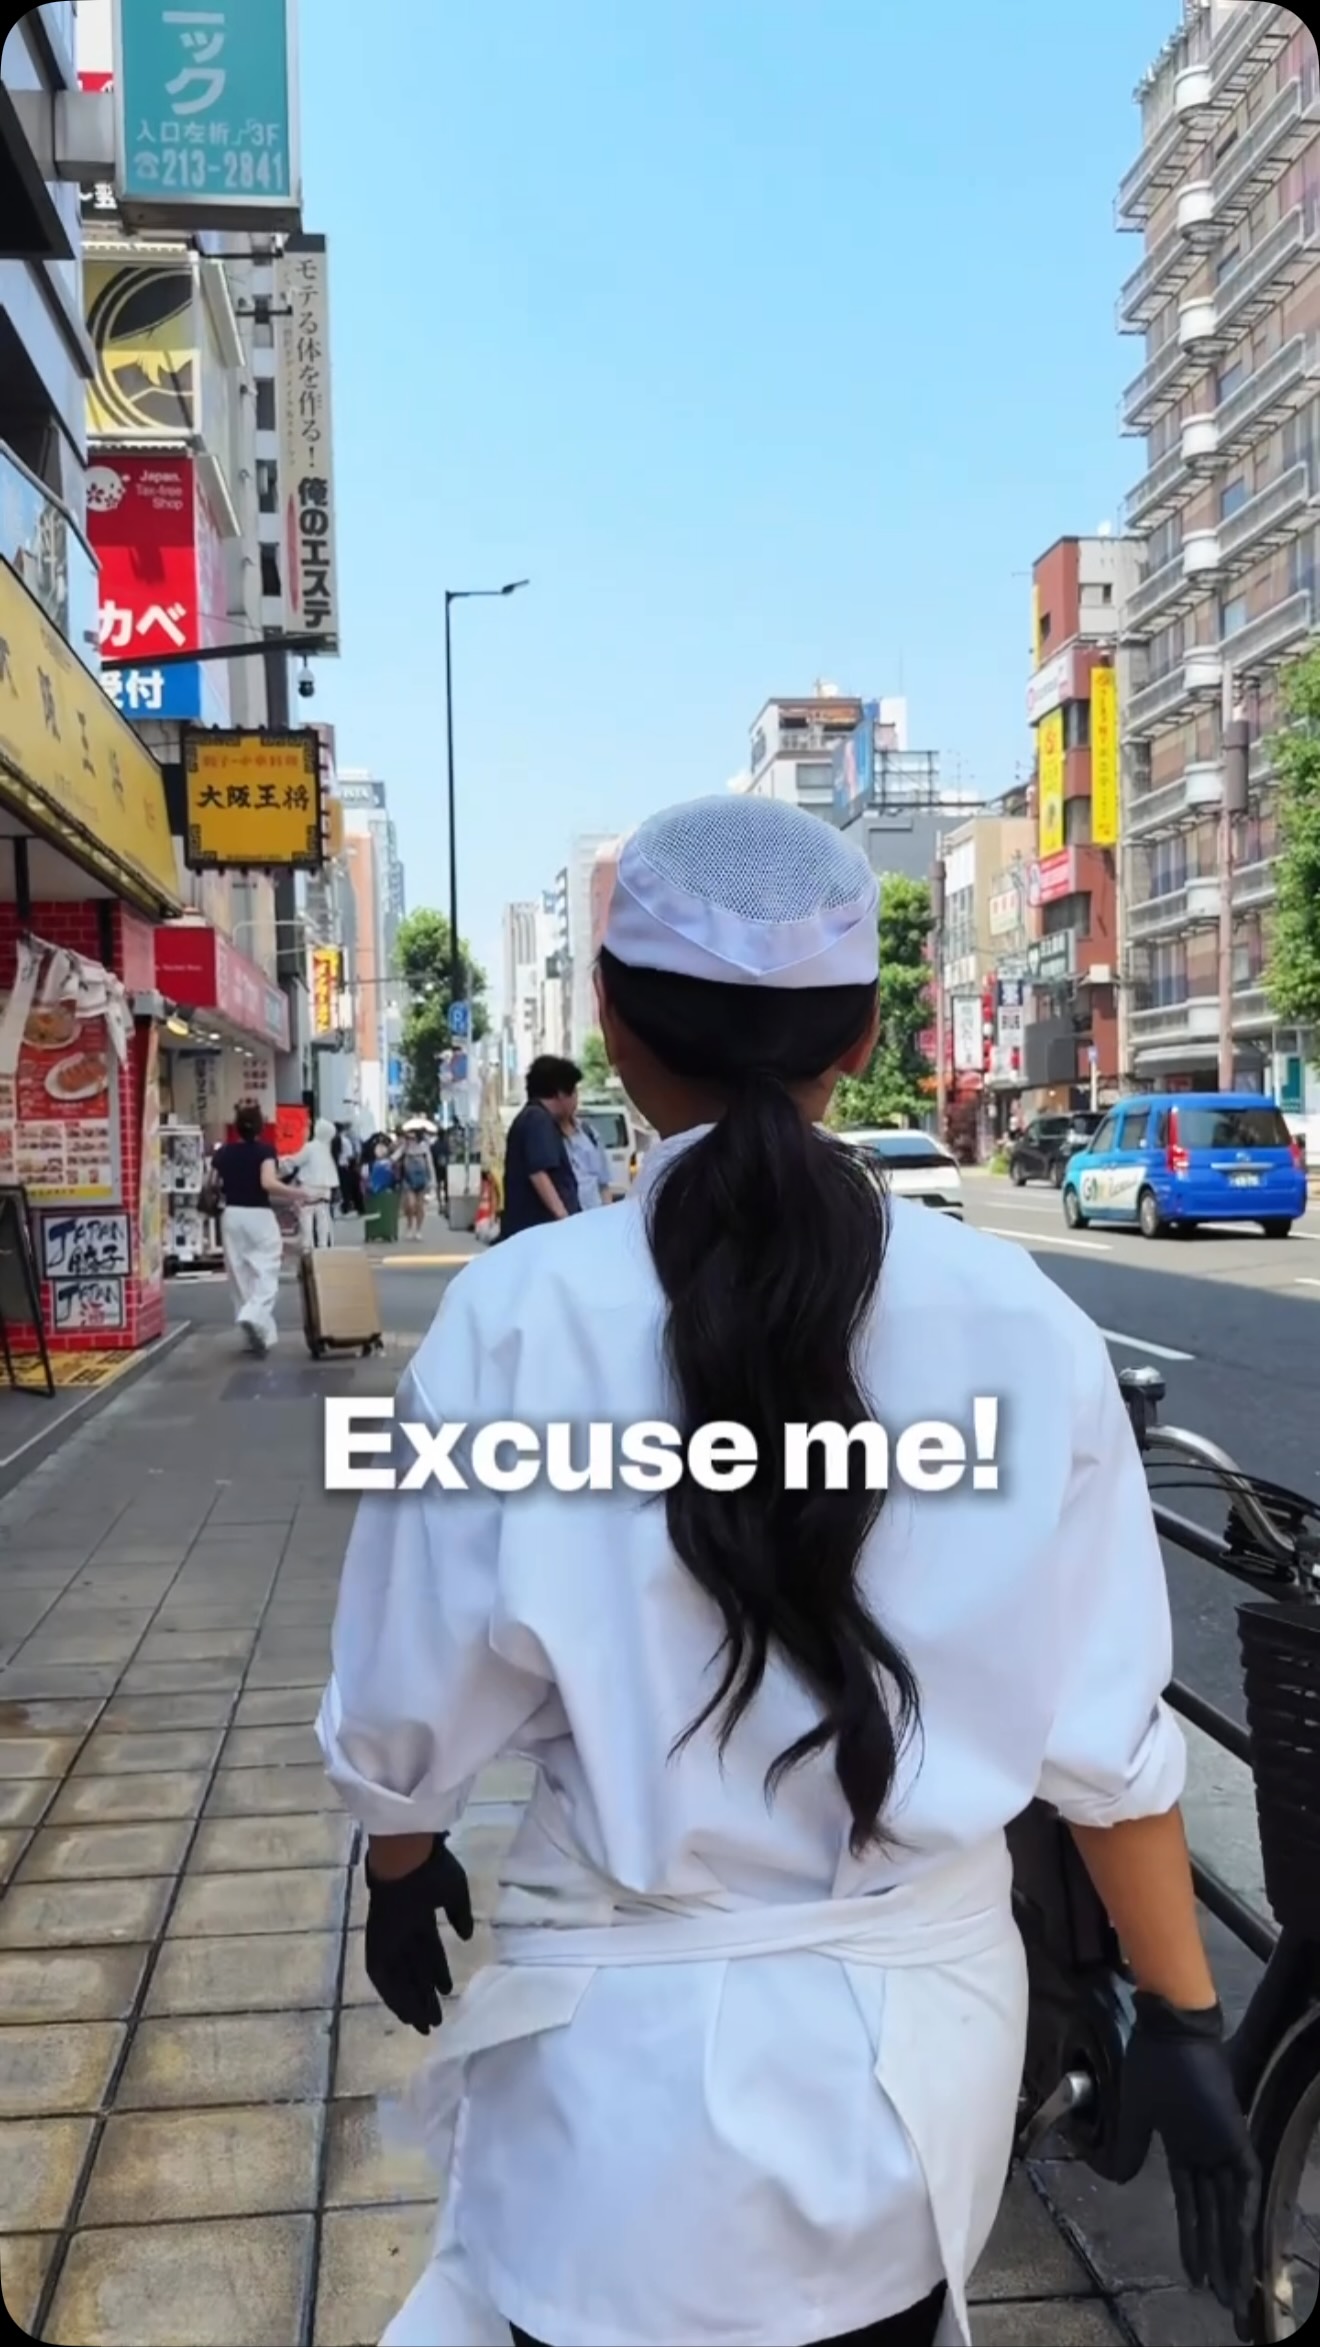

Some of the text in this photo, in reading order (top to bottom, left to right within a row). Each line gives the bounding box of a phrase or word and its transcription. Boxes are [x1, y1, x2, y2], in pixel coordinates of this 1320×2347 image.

[137, 120, 280, 147] 入口左折 3F
[161, 149, 284, 190] 213-2841
[136, 484, 183, 497] Tax-free
[152, 497, 183, 511] Shop
[298, 476, 331, 629] 俺のエステ
[196, 783, 310, 812] 大阪王将
